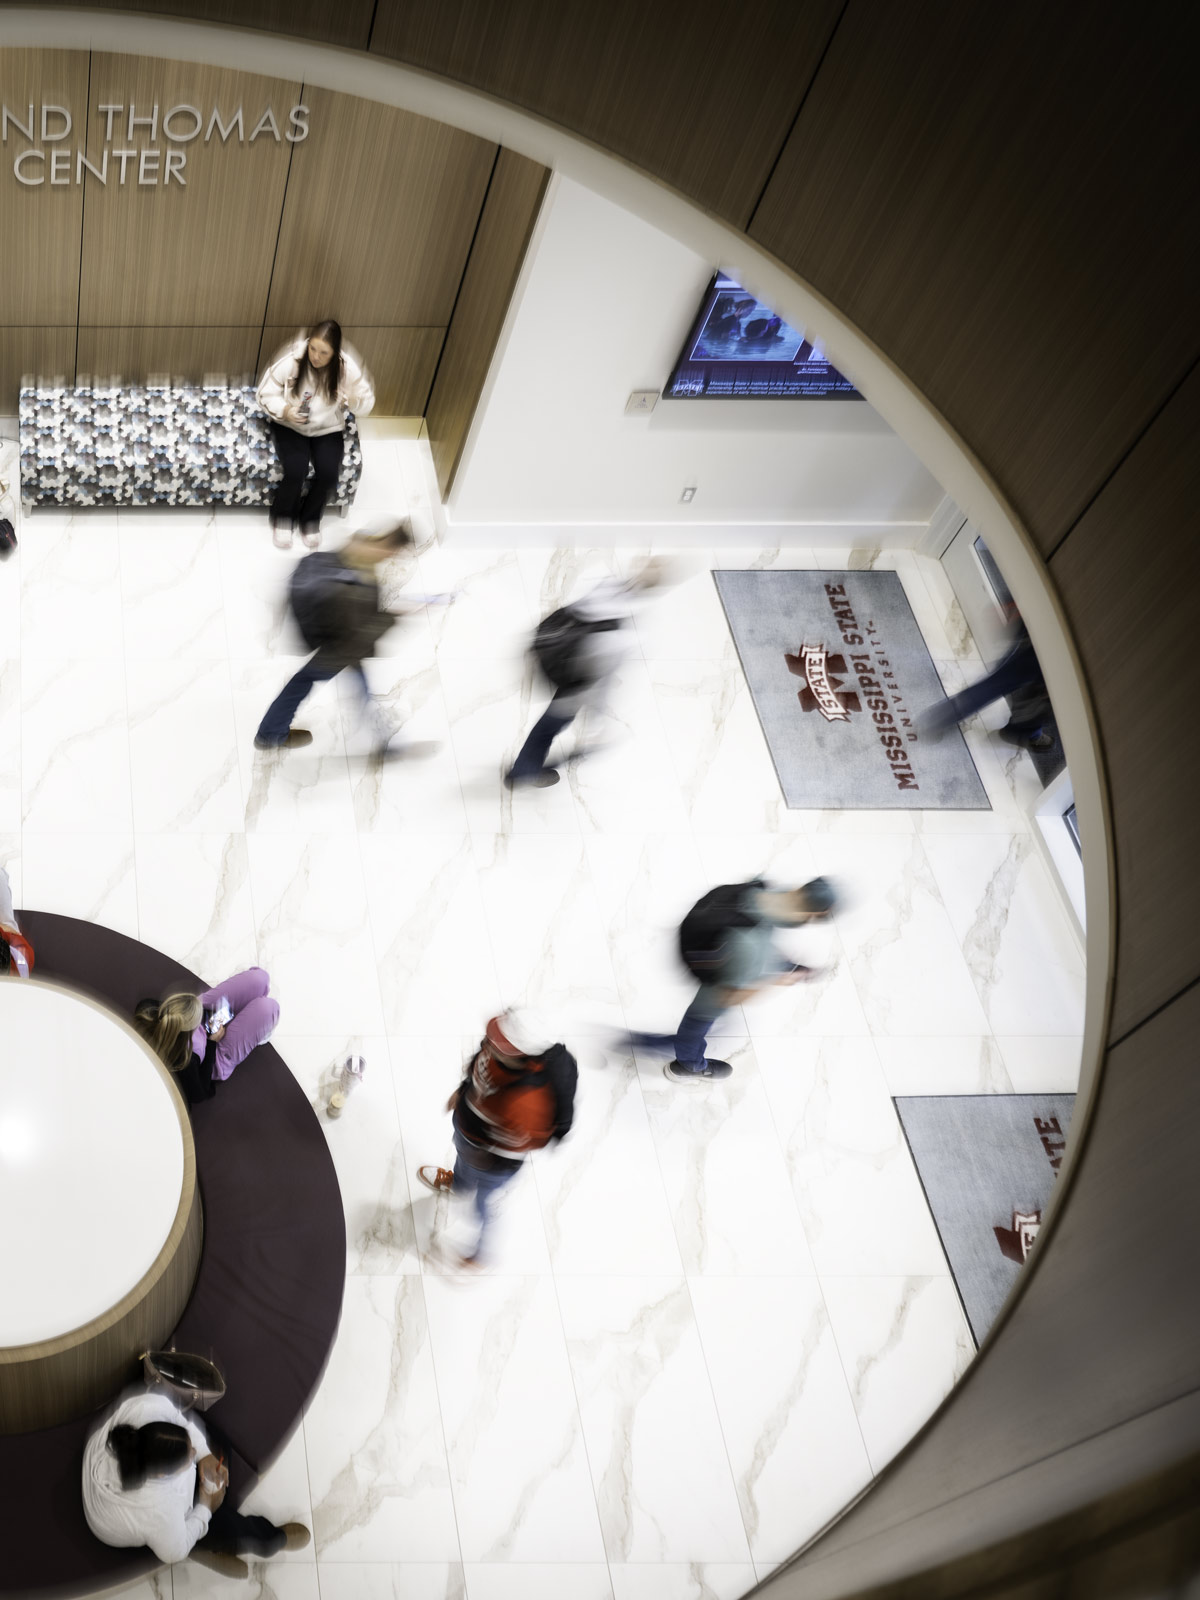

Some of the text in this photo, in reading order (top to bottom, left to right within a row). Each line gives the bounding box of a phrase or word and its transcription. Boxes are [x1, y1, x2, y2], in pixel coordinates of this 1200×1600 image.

[98, 104, 310, 142] THOMAS
[13, 149, 187, 185] CENTER
[808, 656, 840, 709] STATE
[824, 584, 920, 791] MISSISSIPPI STATE
[866, 626, 919, 742] UNIVERSITY
